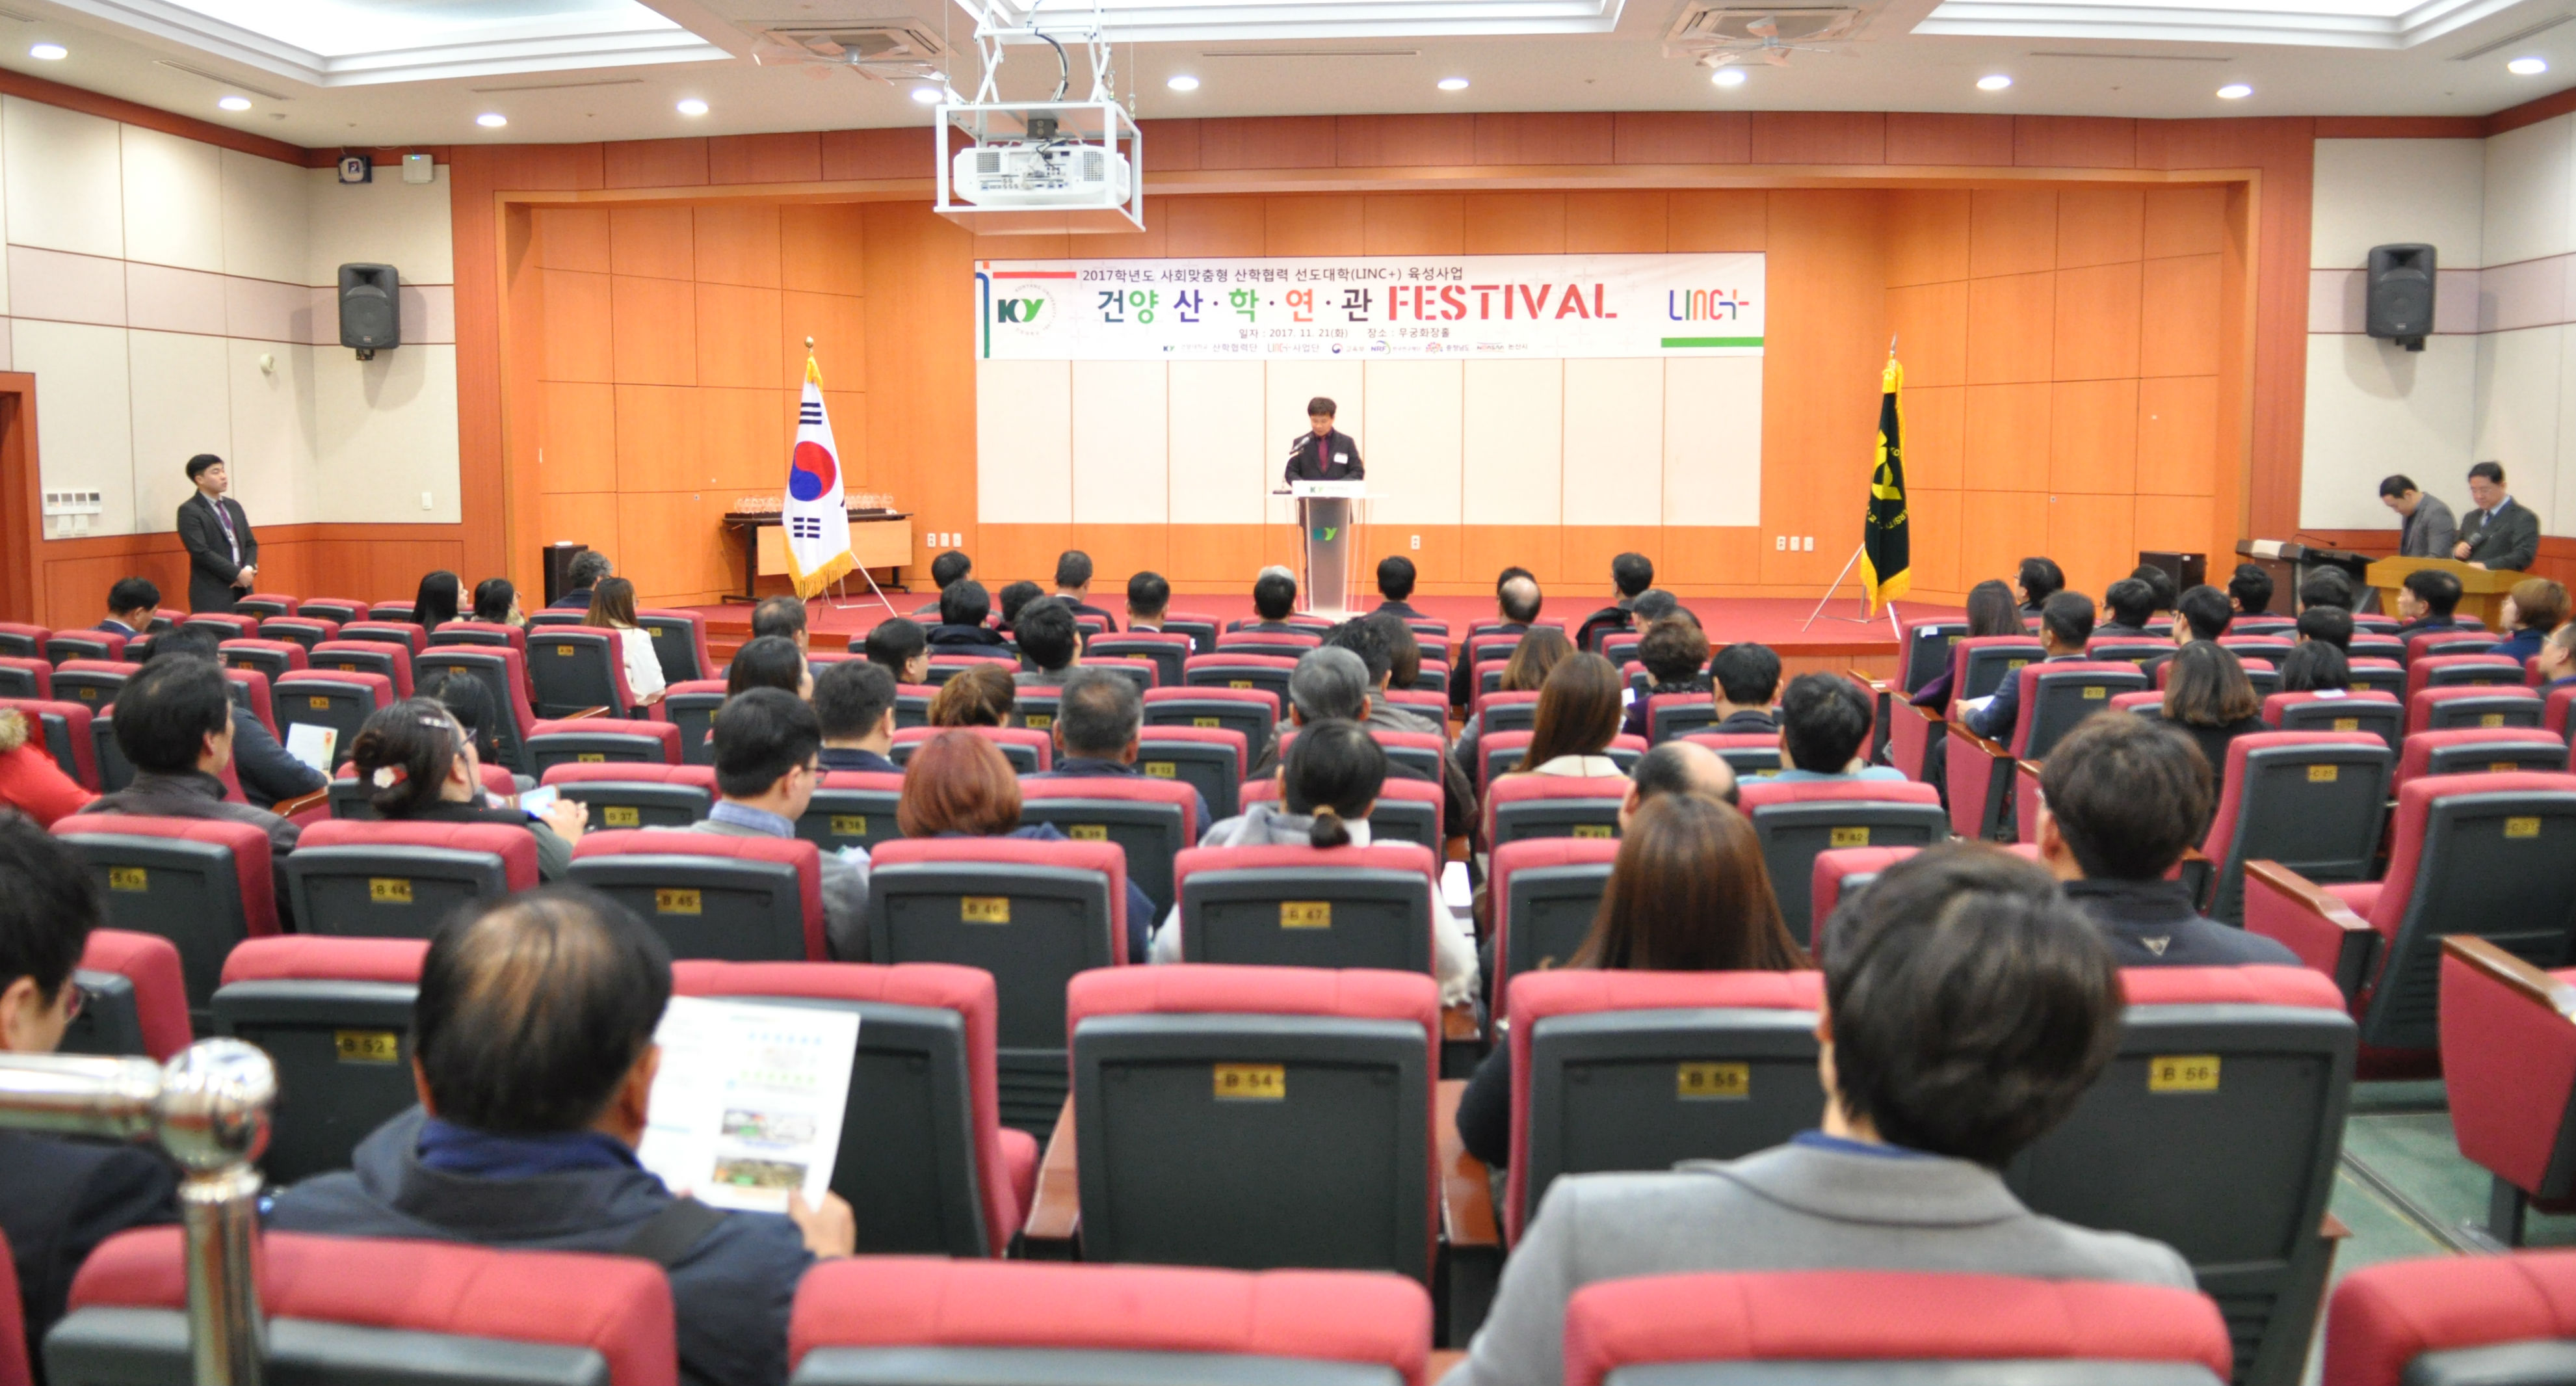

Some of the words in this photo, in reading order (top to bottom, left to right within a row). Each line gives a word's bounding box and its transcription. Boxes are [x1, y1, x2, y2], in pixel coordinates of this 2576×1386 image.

[1083, 269, 1154, 282] 2017학년도
[1161, 269, 1228, 282] 사회맞춤형
[1235, 268, 1288, 282] 산학협력
[1295, 267, 1402, 282] 선도대학(LINC+)
[1408, 267, 1463, 281] 육성사업
[1097, 289, 1159, 325] 건양
[1388, 283, 1618, 321] FESTIVAL
[1399, 327, 1450, 338] 무궁화장홀
[376, 885, 385, 895] B
[677, 896, 693, 907] 45
[1306, 909, 1323, 920] 47
[363, 1038, 385, 1053] 52
[2163, 1067, 2176, 1081] B
[2186, 1066, 2209, 1081] 56
